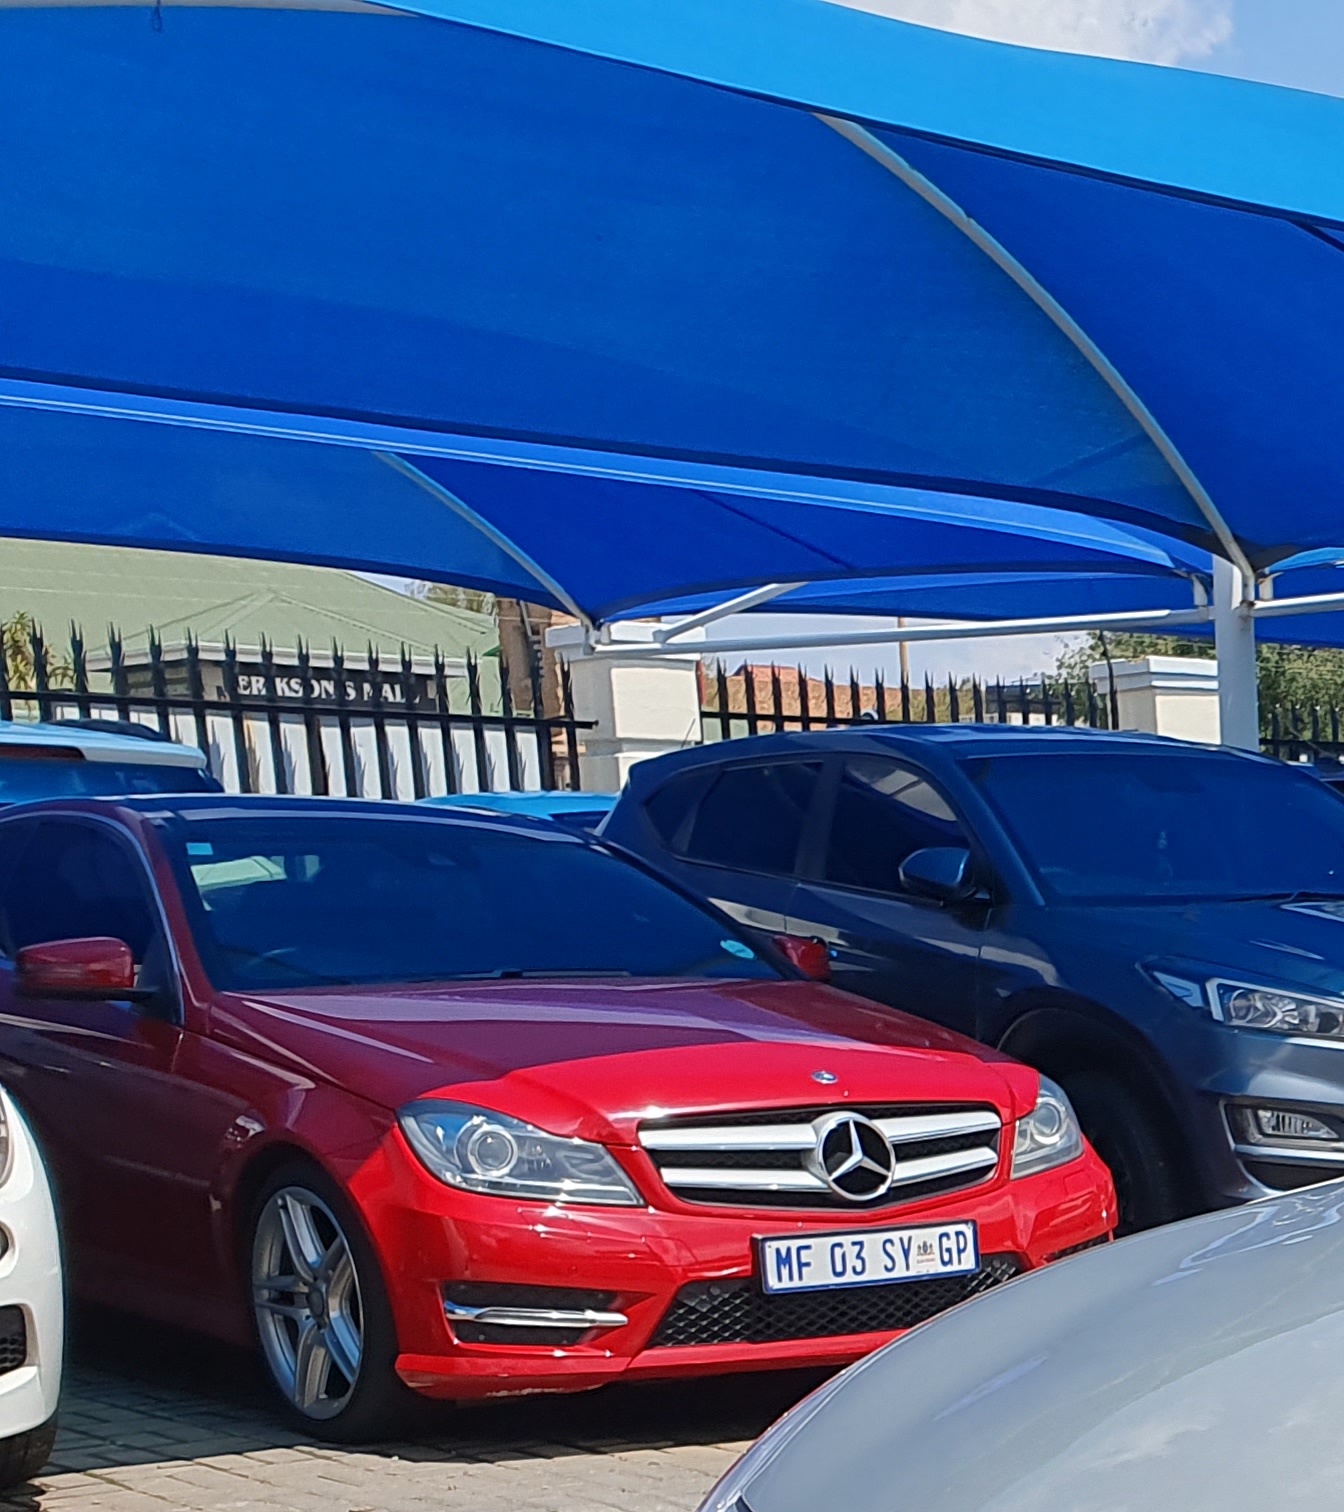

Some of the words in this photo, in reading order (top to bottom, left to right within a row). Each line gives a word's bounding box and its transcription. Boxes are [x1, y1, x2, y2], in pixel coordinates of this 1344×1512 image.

[363, 681, 421, 703] MAL
[775, 1244, 813, 1283] MF
[830, 1240, 867, 1279] 03
[882, 1235, 913, 1273] SY
[938, 1230, 968, 1267] GP
